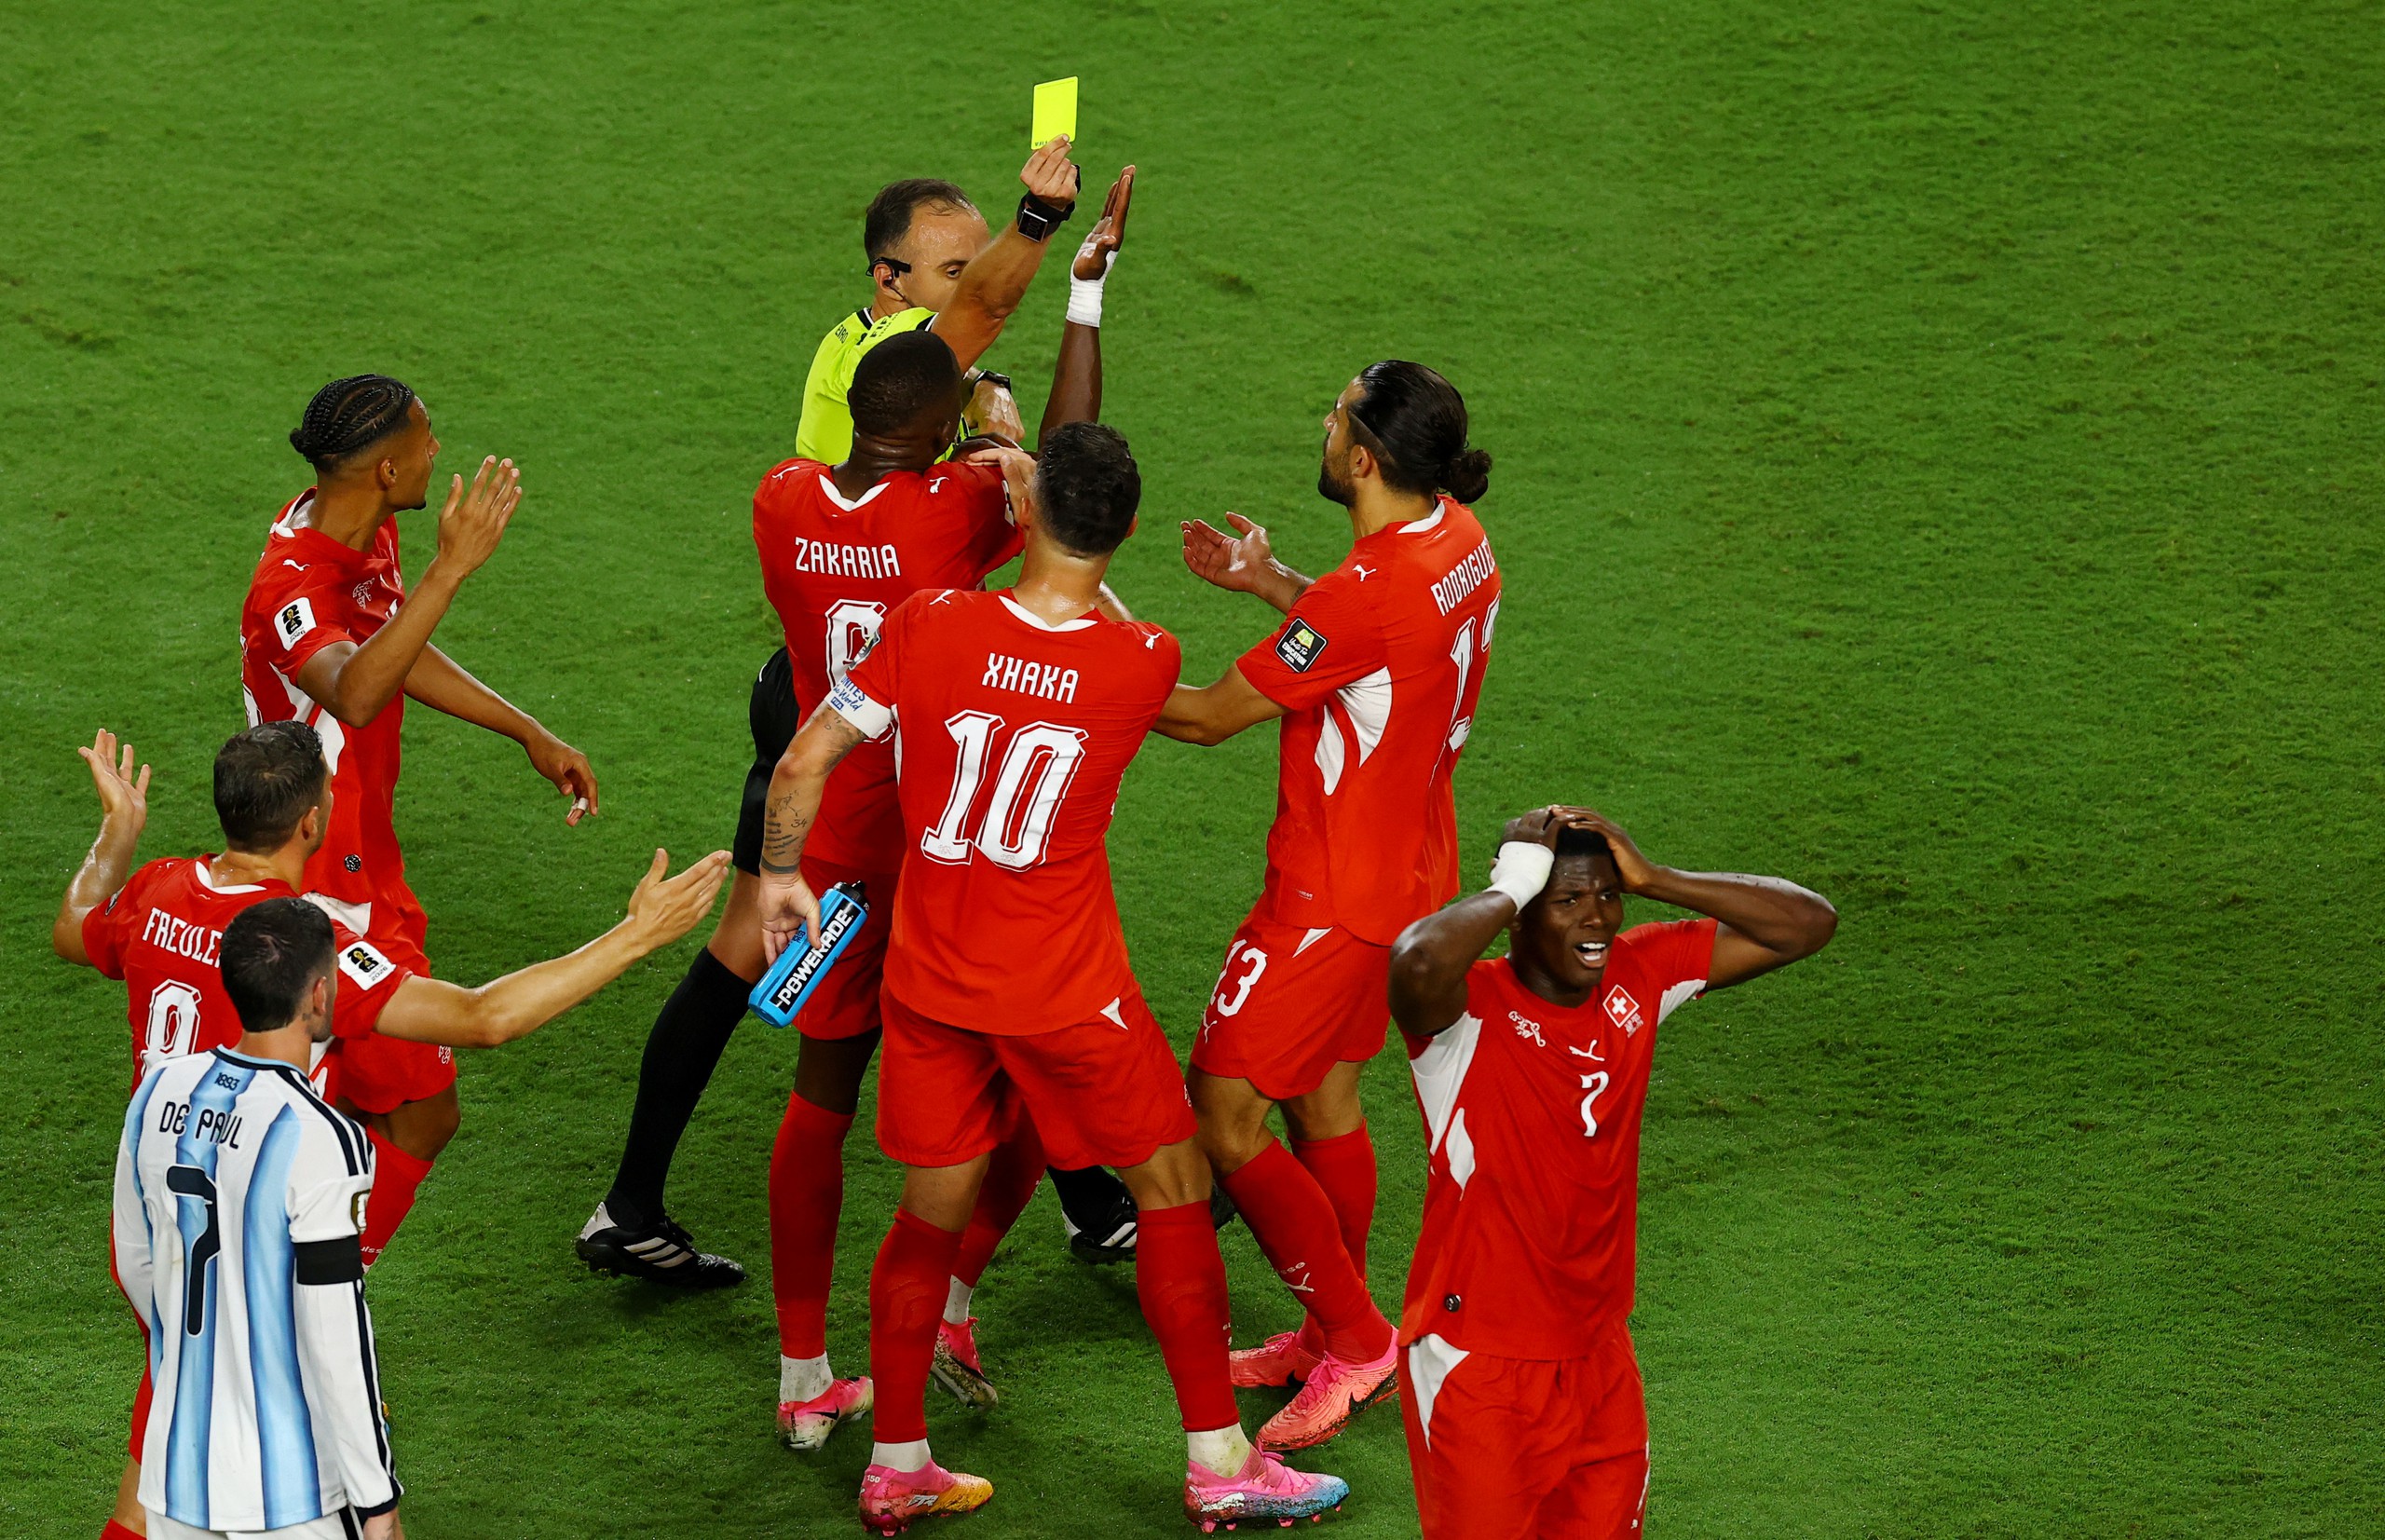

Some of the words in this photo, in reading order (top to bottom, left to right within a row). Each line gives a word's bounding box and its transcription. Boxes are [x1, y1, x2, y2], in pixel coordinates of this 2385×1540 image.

[795, 537, 900, 579] ZAKARIA
[981, 652, 1079, 704] XHAKA
[1281, 641, 1307, 666] EDUCATION
[838, 688, 863, 712] World
[920, 709, 1090, 873] 10
[1210, 938, 1268, 1017] 13
[214, 1072, 240, 1091] 1893
[1579, 1070, 1610, 1137] 7
[159, 1101, 190, 1135] DE
[195, 1109, 242, 1150] PAUL
[165, 1164, 221, 1337] 7
[866, 1474, 880, 1483] 150
